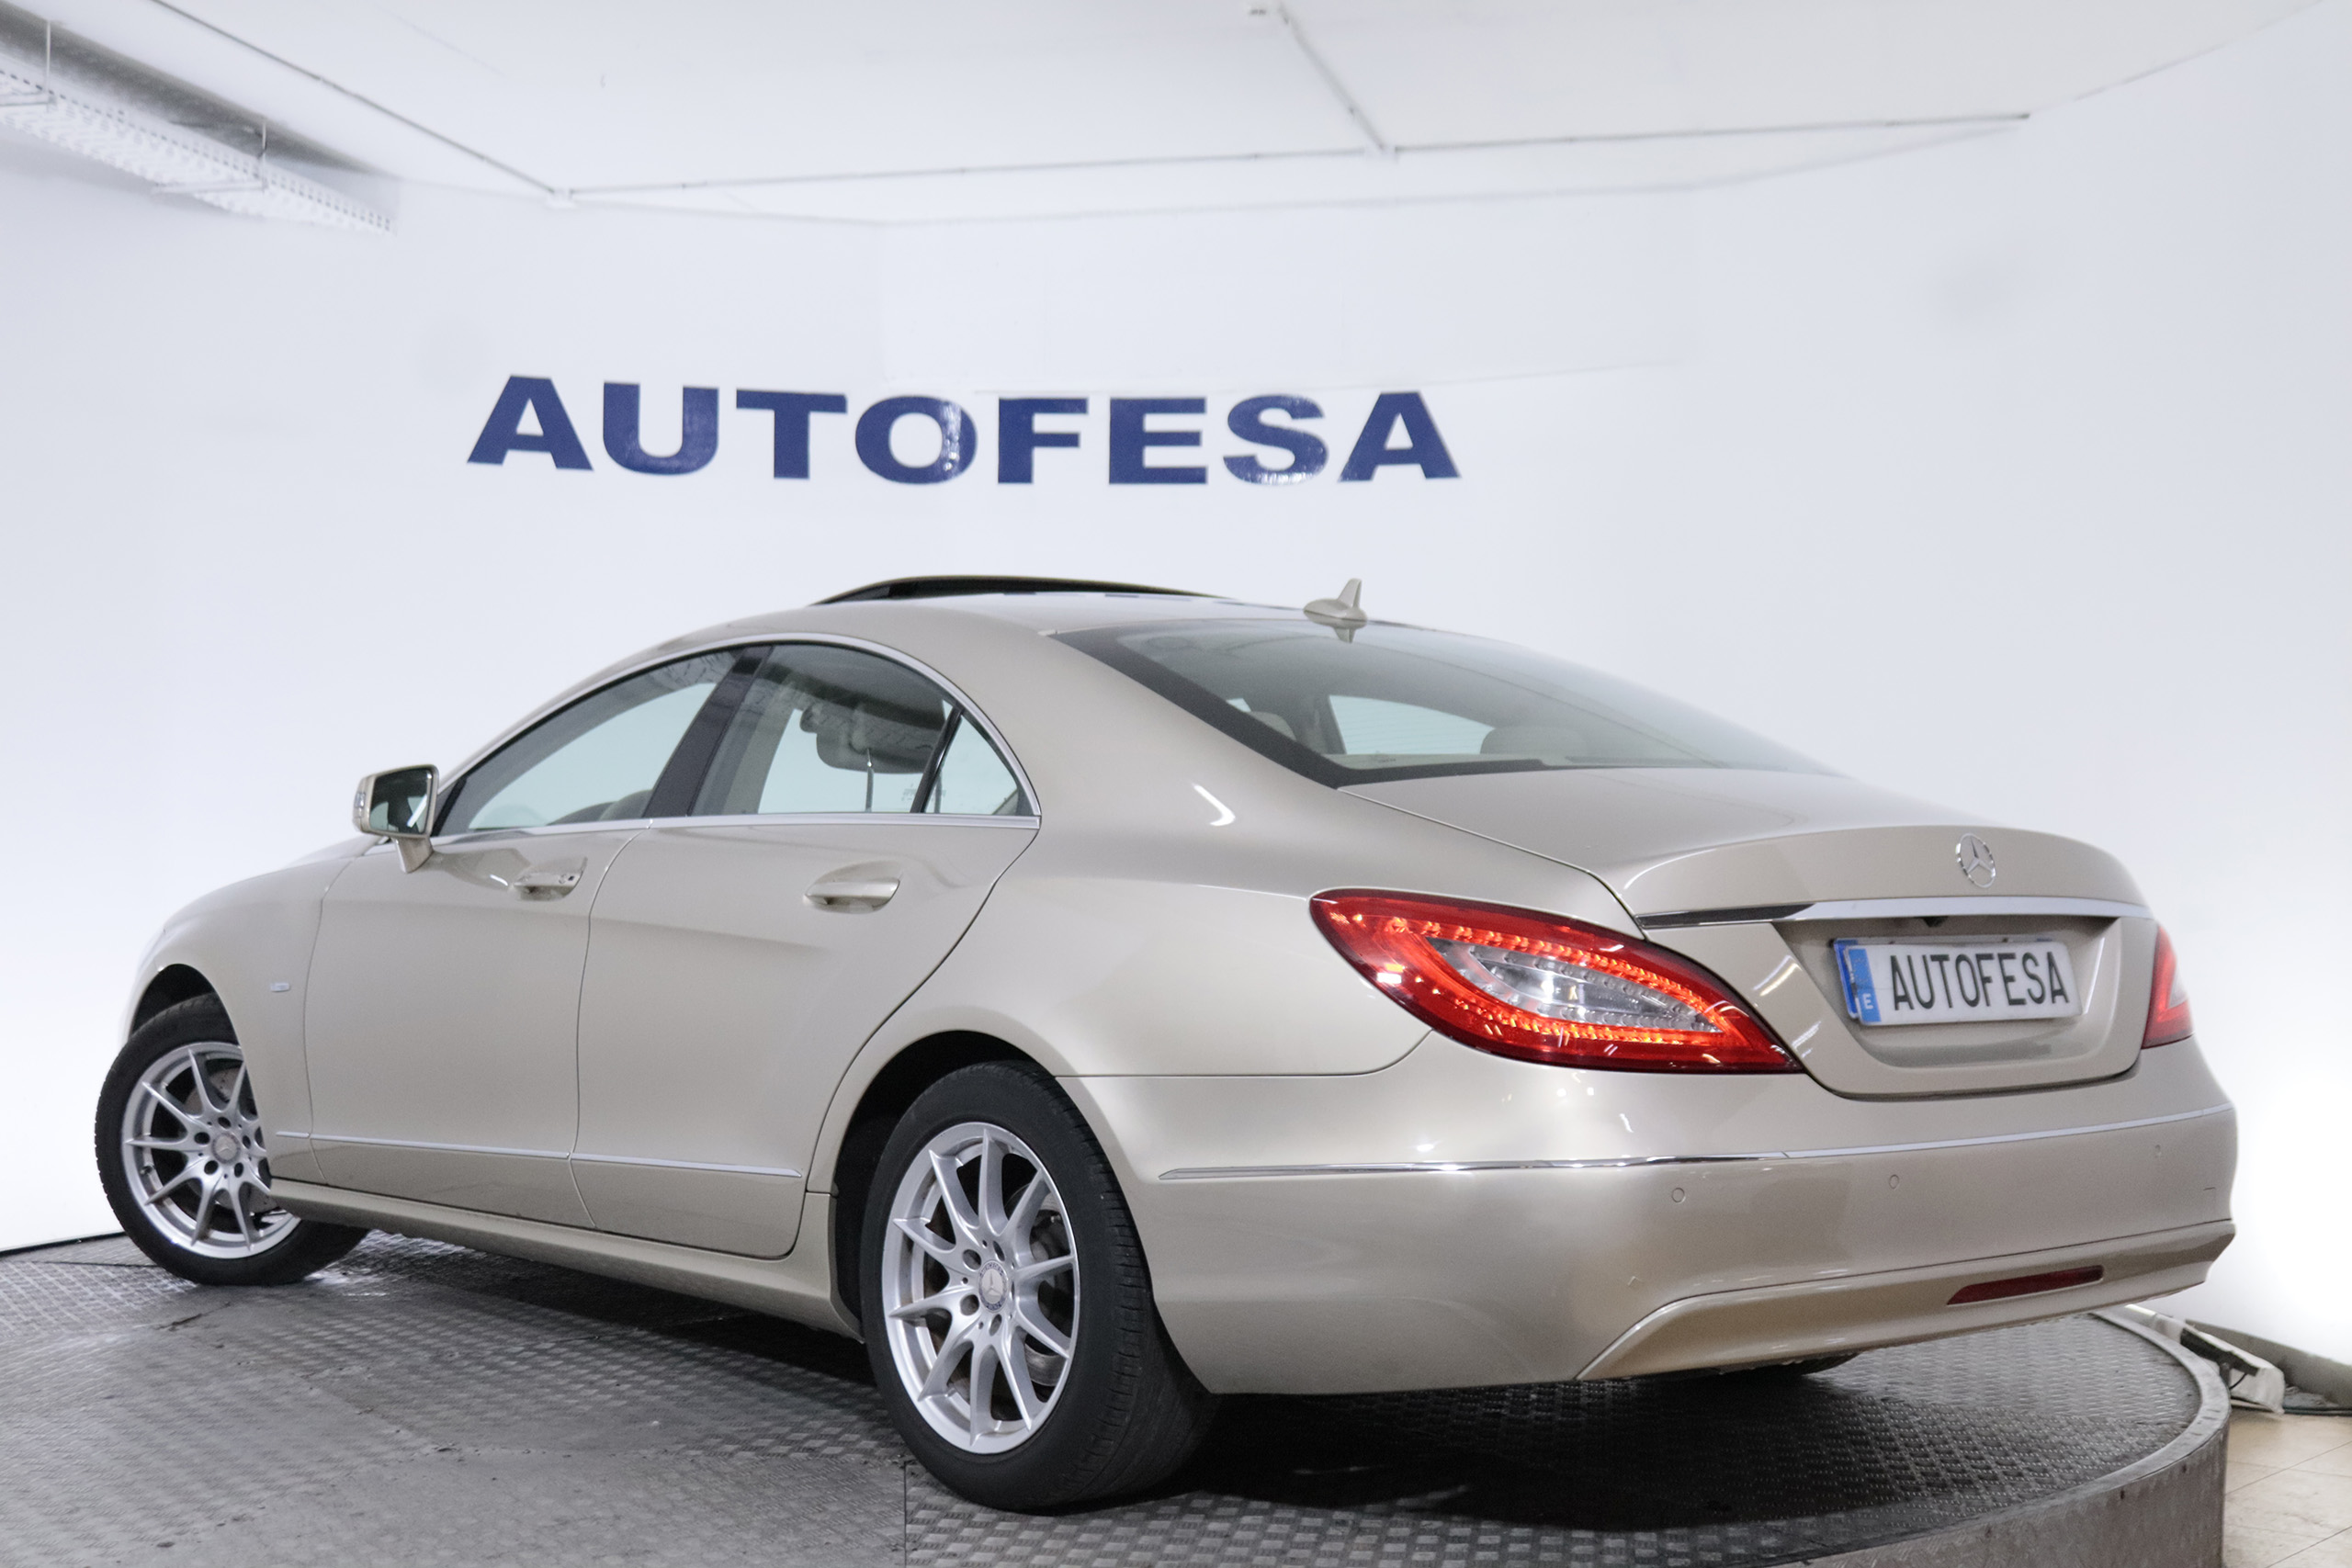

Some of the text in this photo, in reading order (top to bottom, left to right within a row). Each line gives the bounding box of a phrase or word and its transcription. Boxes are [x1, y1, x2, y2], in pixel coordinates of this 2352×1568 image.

[467, 375, 1461, 485] AUTOFESA
[1863, 993, 1874, 1010] E
[1890, 952, 2069, 1010] AUTOFESA
